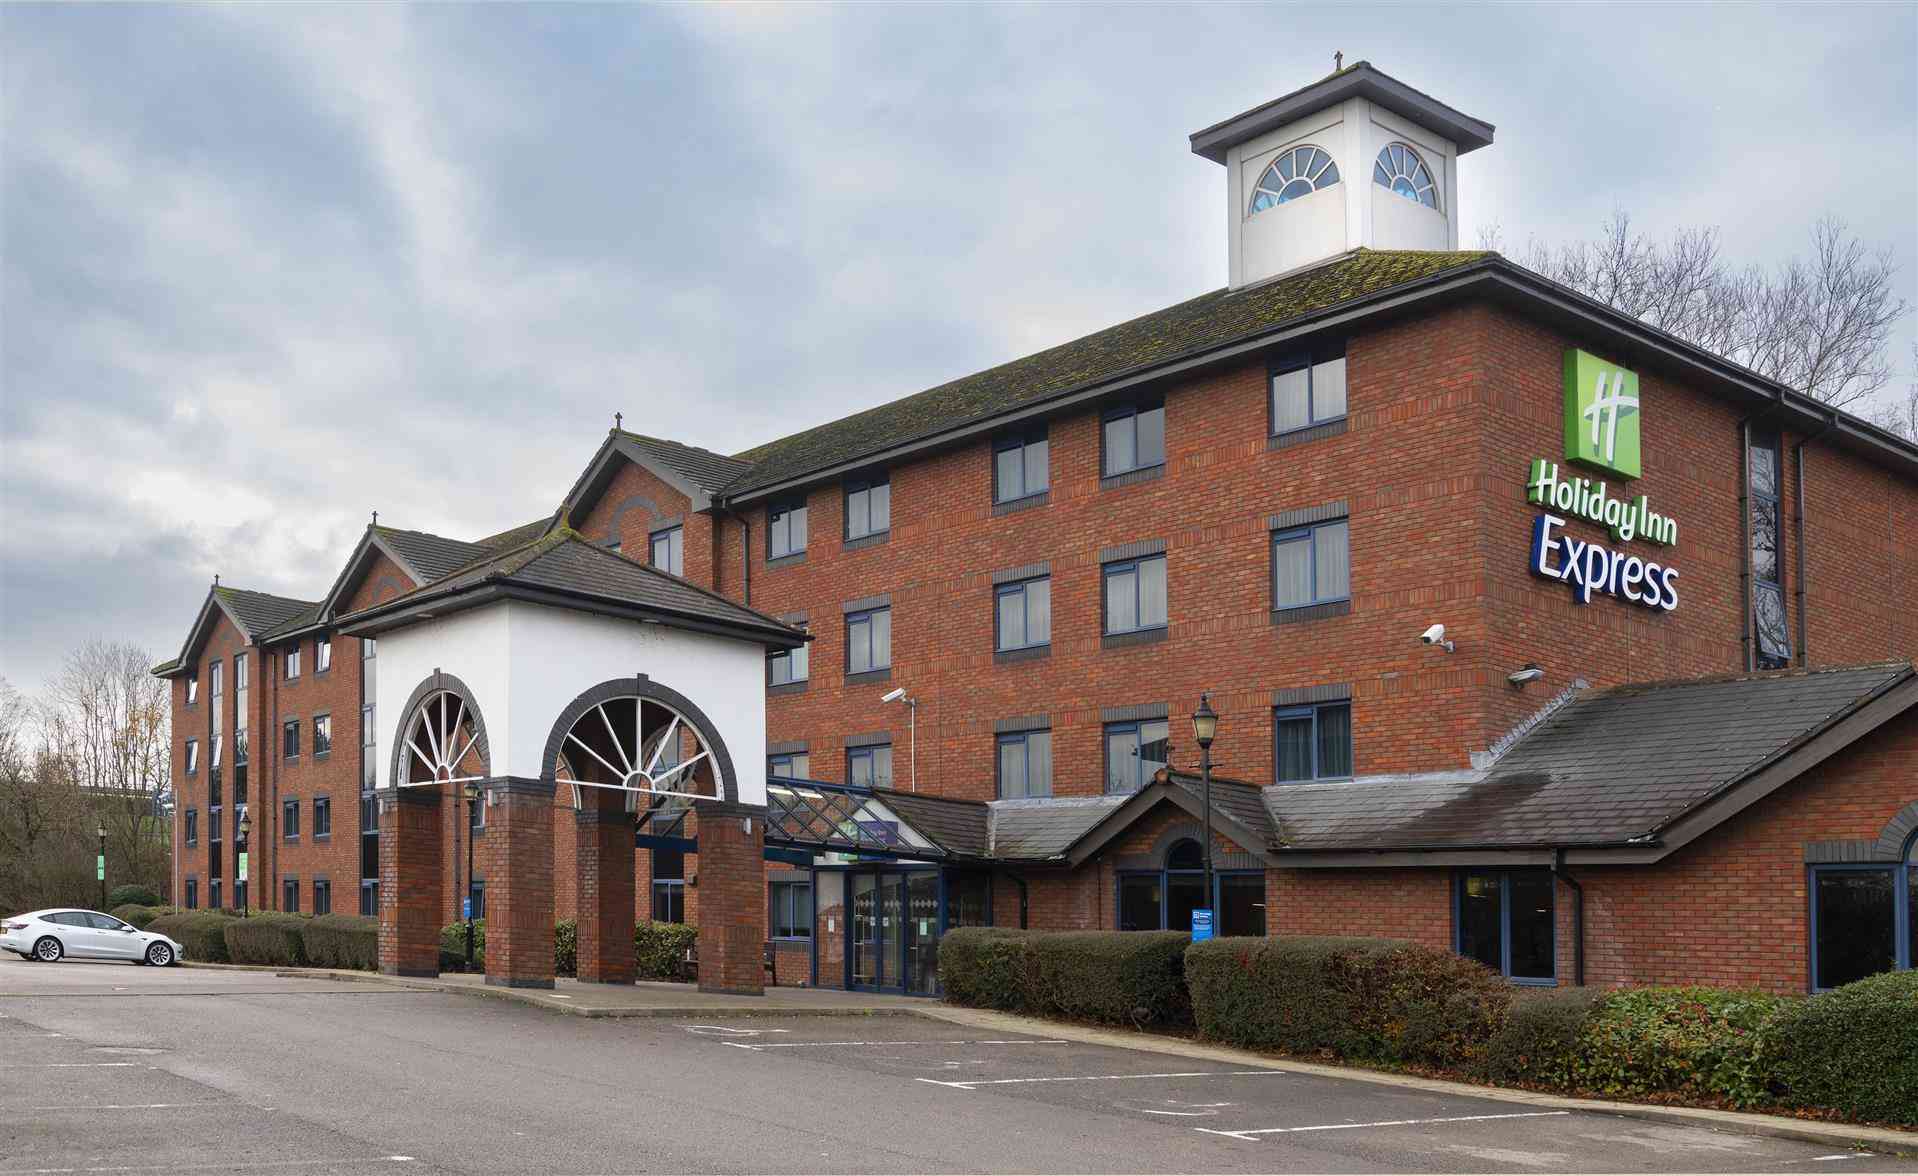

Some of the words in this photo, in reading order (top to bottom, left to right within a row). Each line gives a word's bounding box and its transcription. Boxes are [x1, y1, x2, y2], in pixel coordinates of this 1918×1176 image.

[1534, 458, 1638, 541] Holiday
[1640, 495, 1677, 546] Inn
[1538, 513, 1680, 611] Express
